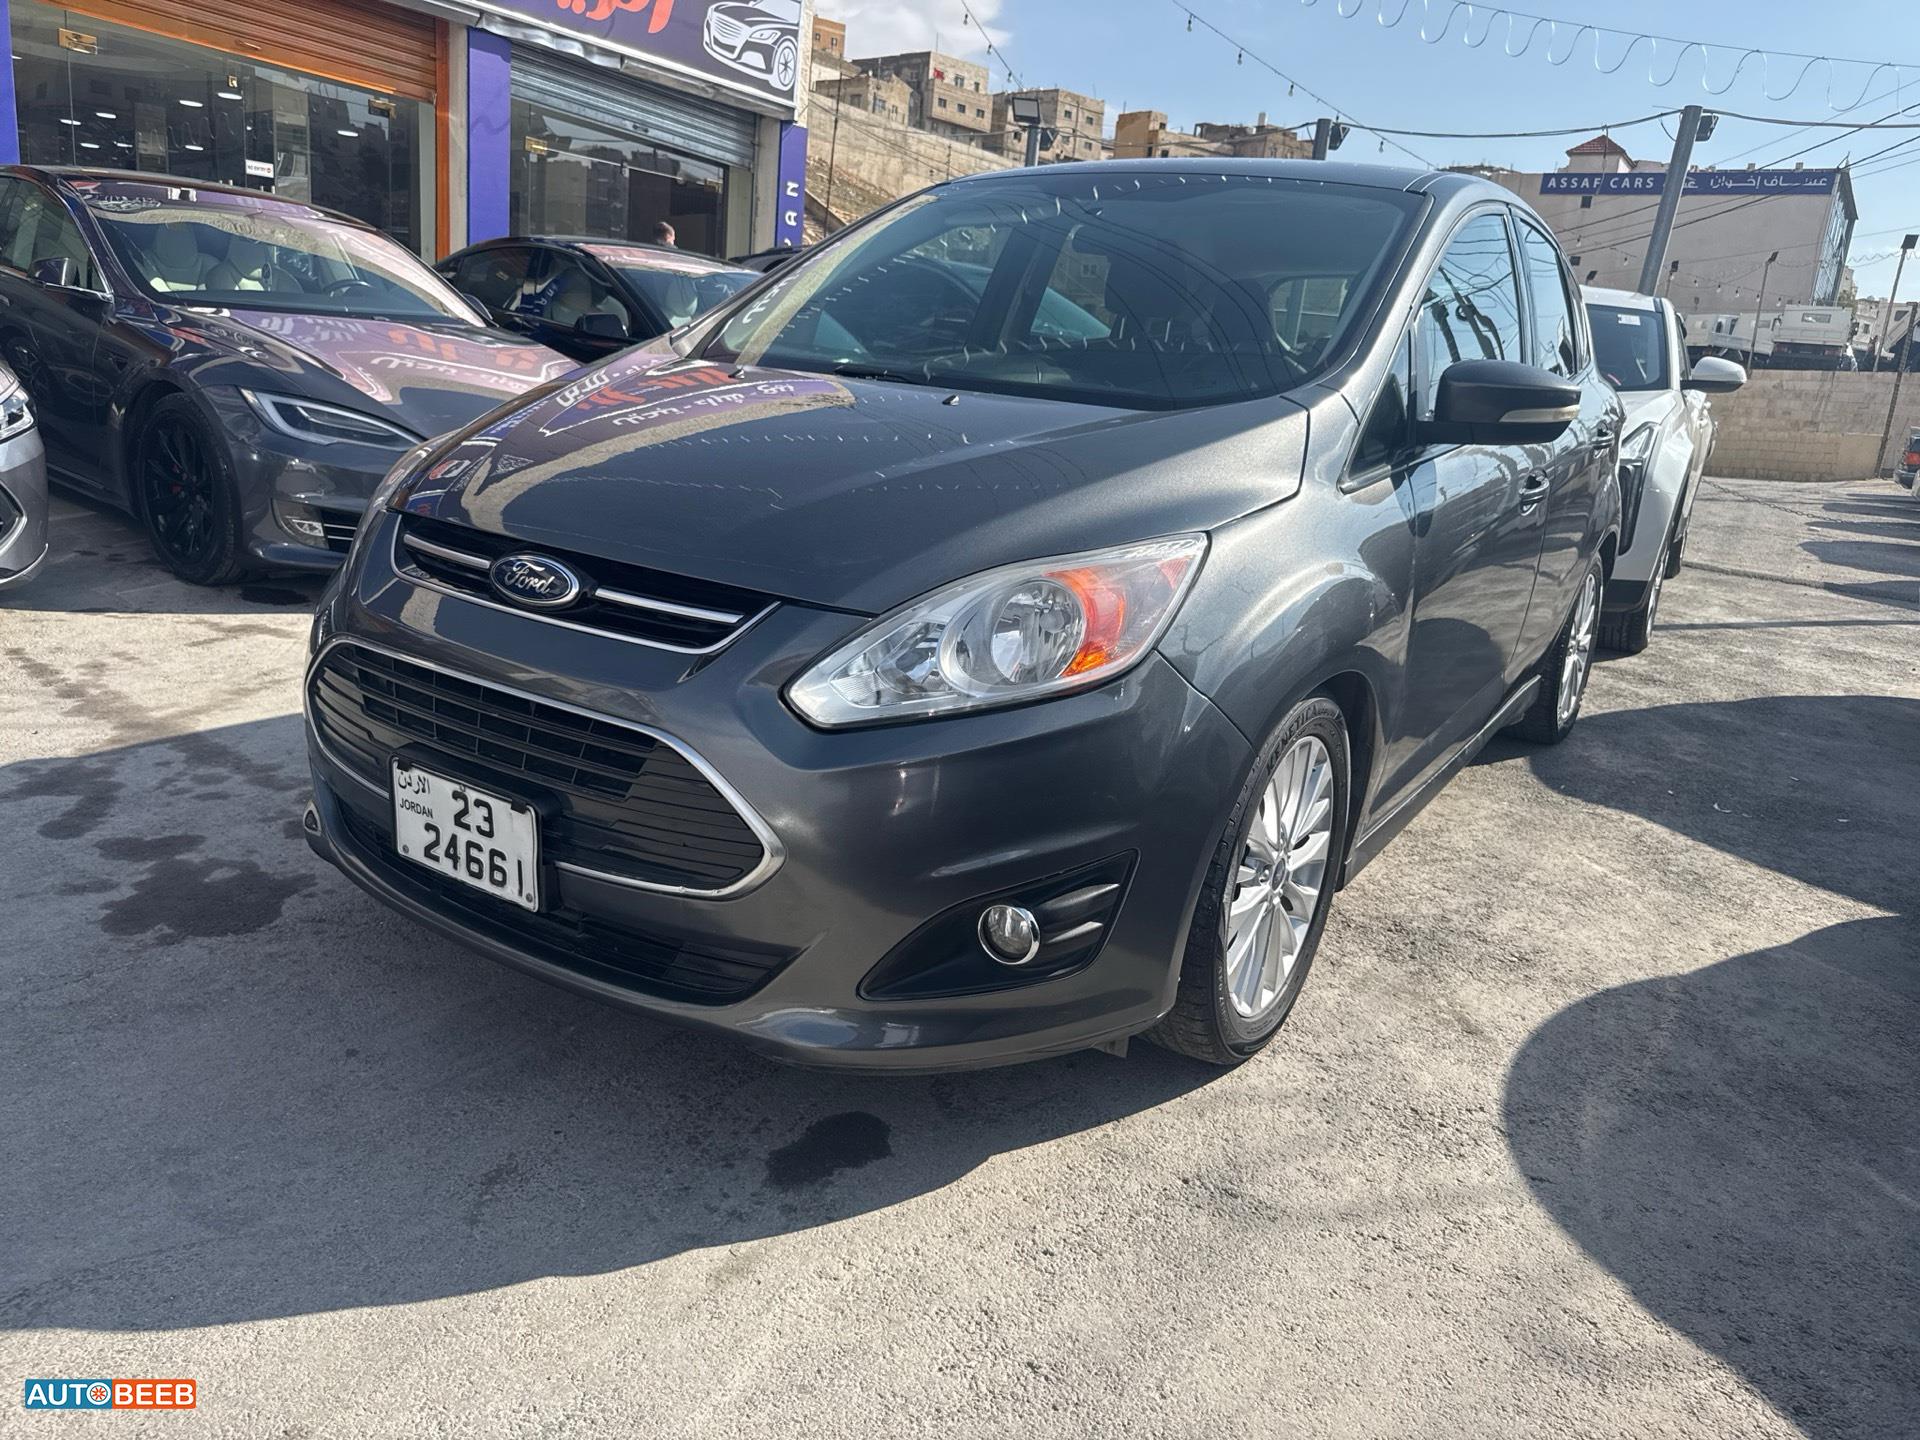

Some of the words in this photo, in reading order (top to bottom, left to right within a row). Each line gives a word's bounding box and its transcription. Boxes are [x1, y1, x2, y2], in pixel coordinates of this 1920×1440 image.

[1547, 177, 1601, 189] ASSAF
[1609, 177, 1655, 189] CARS
[504, 561, 555, 594] Ford
[400, 798, 433, 819] JORDAN
[452, 790, 495, 839] 23
[424, 822, 523, 898] 24661
